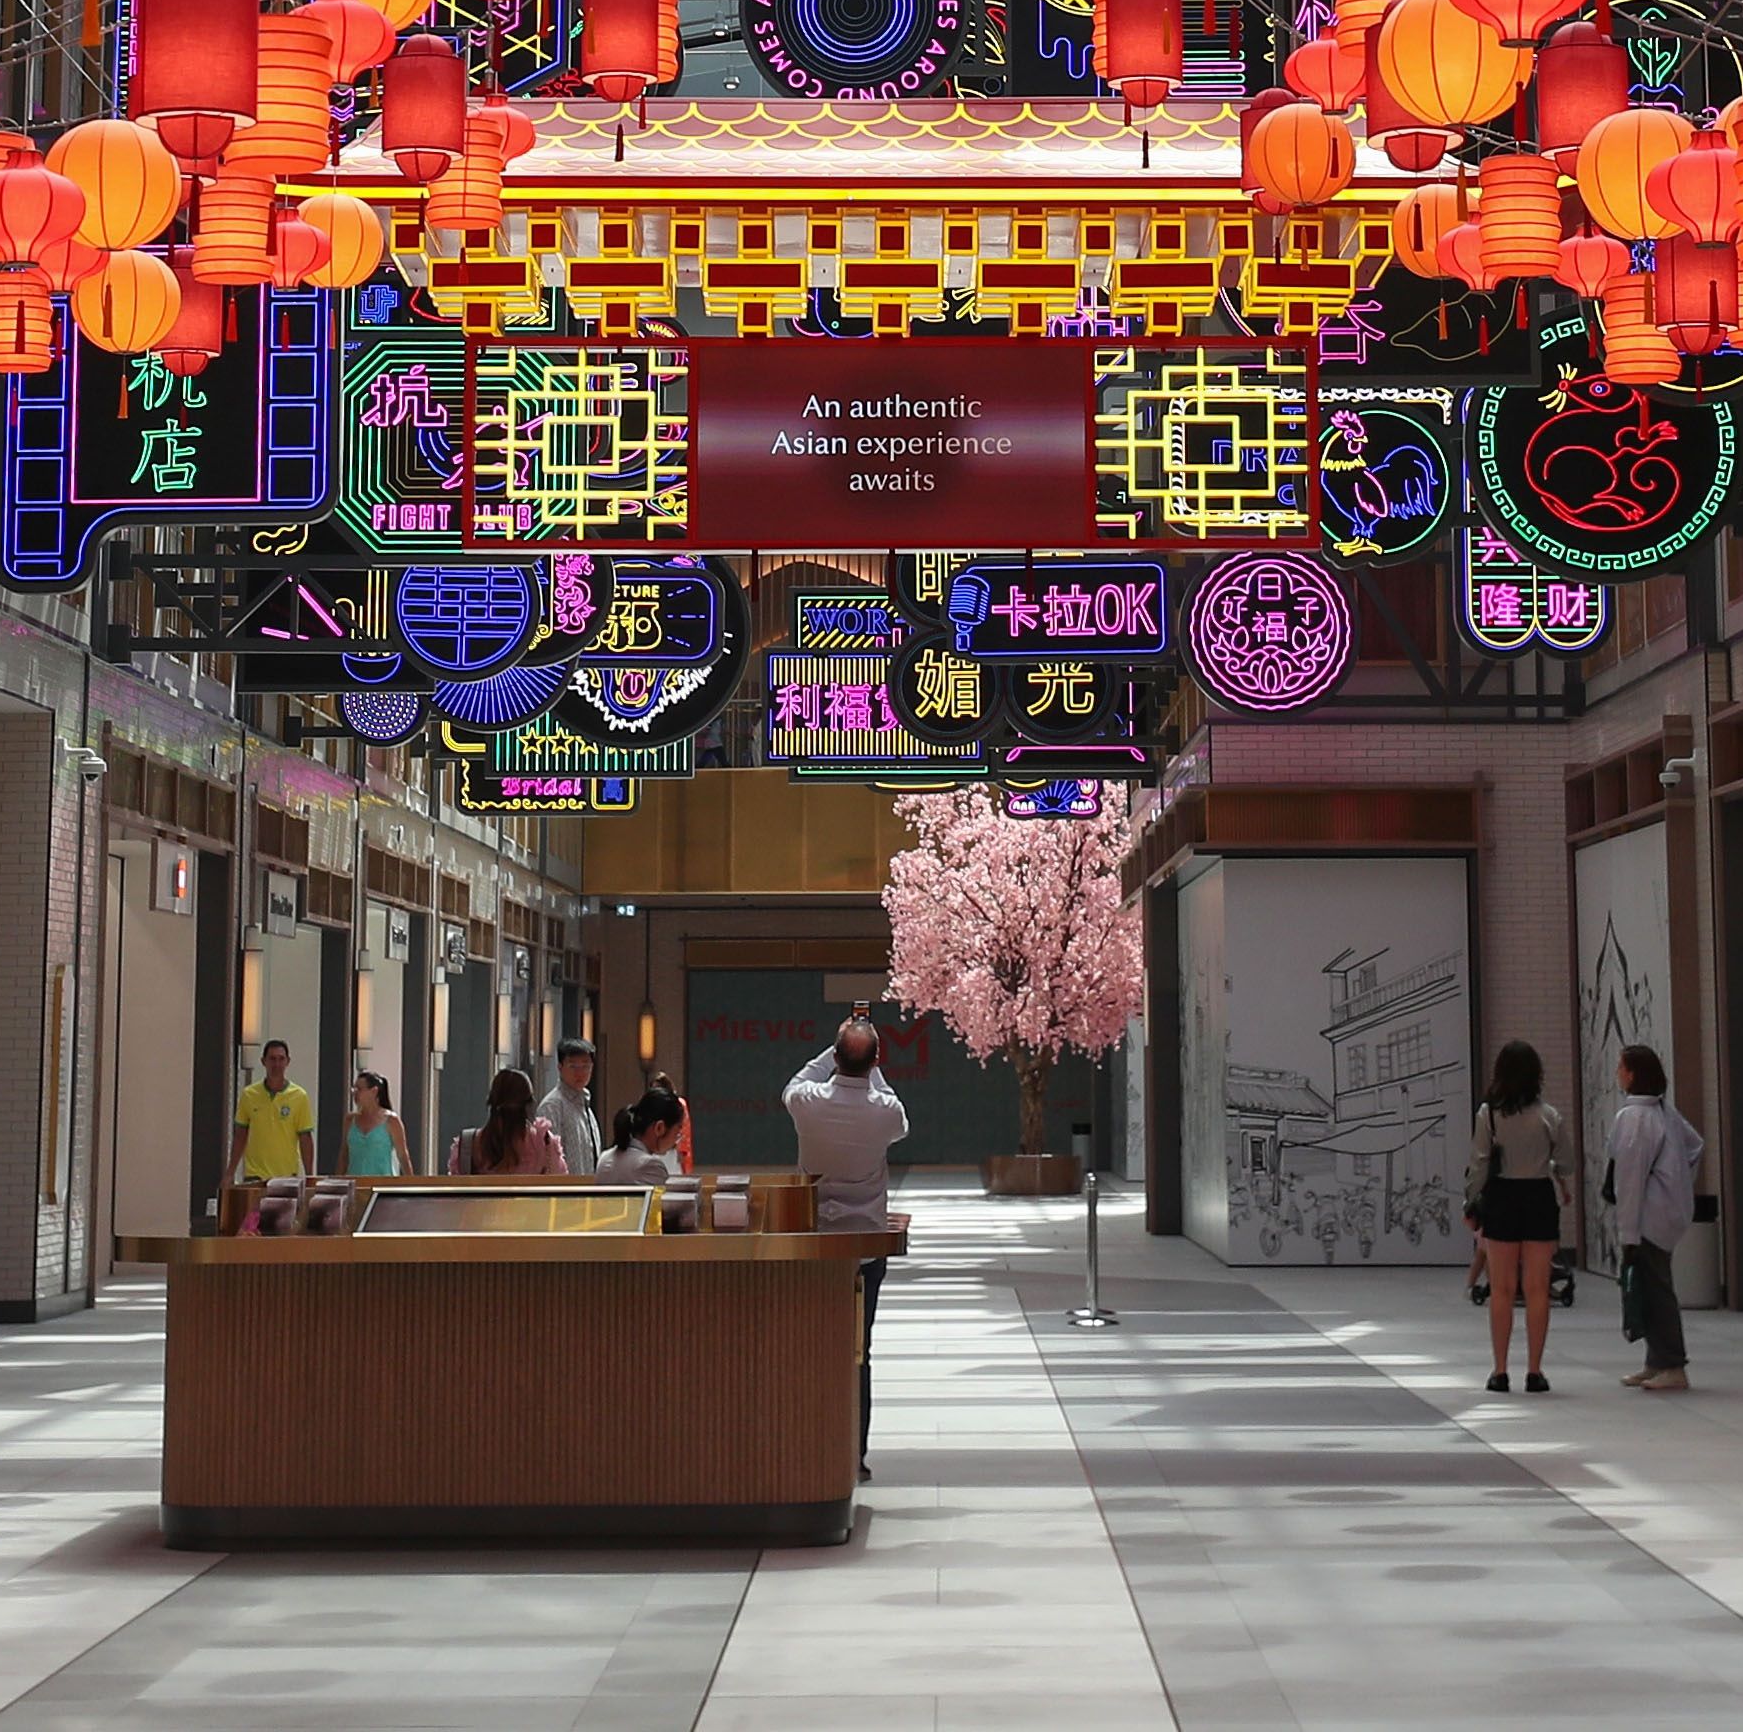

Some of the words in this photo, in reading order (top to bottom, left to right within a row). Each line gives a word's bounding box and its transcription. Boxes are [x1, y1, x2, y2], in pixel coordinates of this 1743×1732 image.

[753, 19, 824, 98] COMES
[802, 394, 841, 418] An
[849, 393, 983, 419] authentic
[770, 431, 848, 455] Asian
[857, 431, 1013, 463] experience
[849, 467, 936, 492] awaits
[372, 504, 452, 531] FIGHT
[474, 504, 533, 531] LUB
[803, 608, 906, 636] WOR
[991, 582, 1159, 637] 卡拉OK
[501, 776, 582, 797] Bridal
